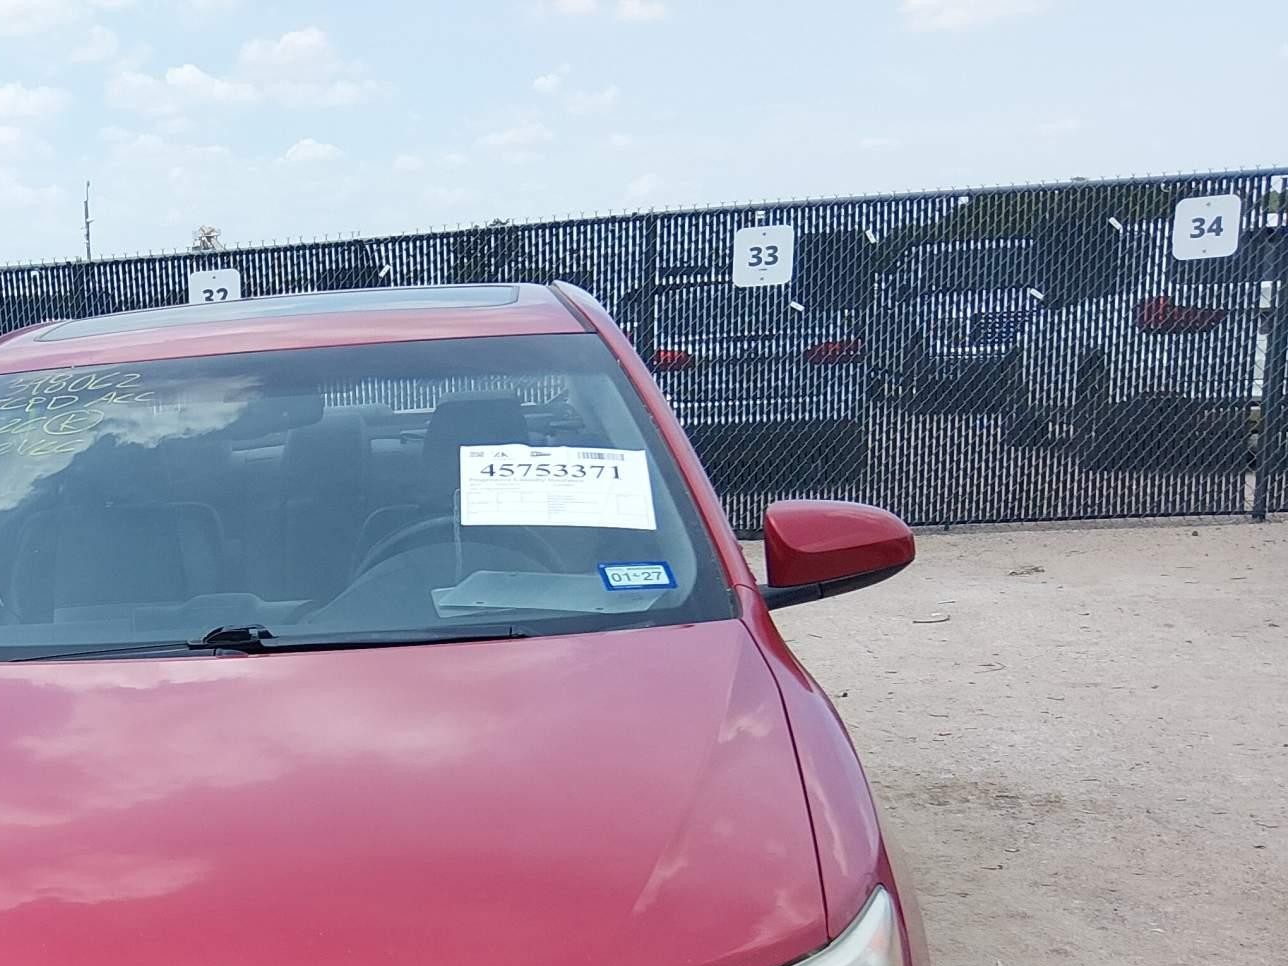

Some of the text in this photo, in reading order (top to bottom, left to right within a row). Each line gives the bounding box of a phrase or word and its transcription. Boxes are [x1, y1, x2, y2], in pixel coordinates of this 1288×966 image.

[1189, 215, 1224, 240] 34
[748, 244, 779, 267] 33
[479, 463, 621, 480] 45753371
